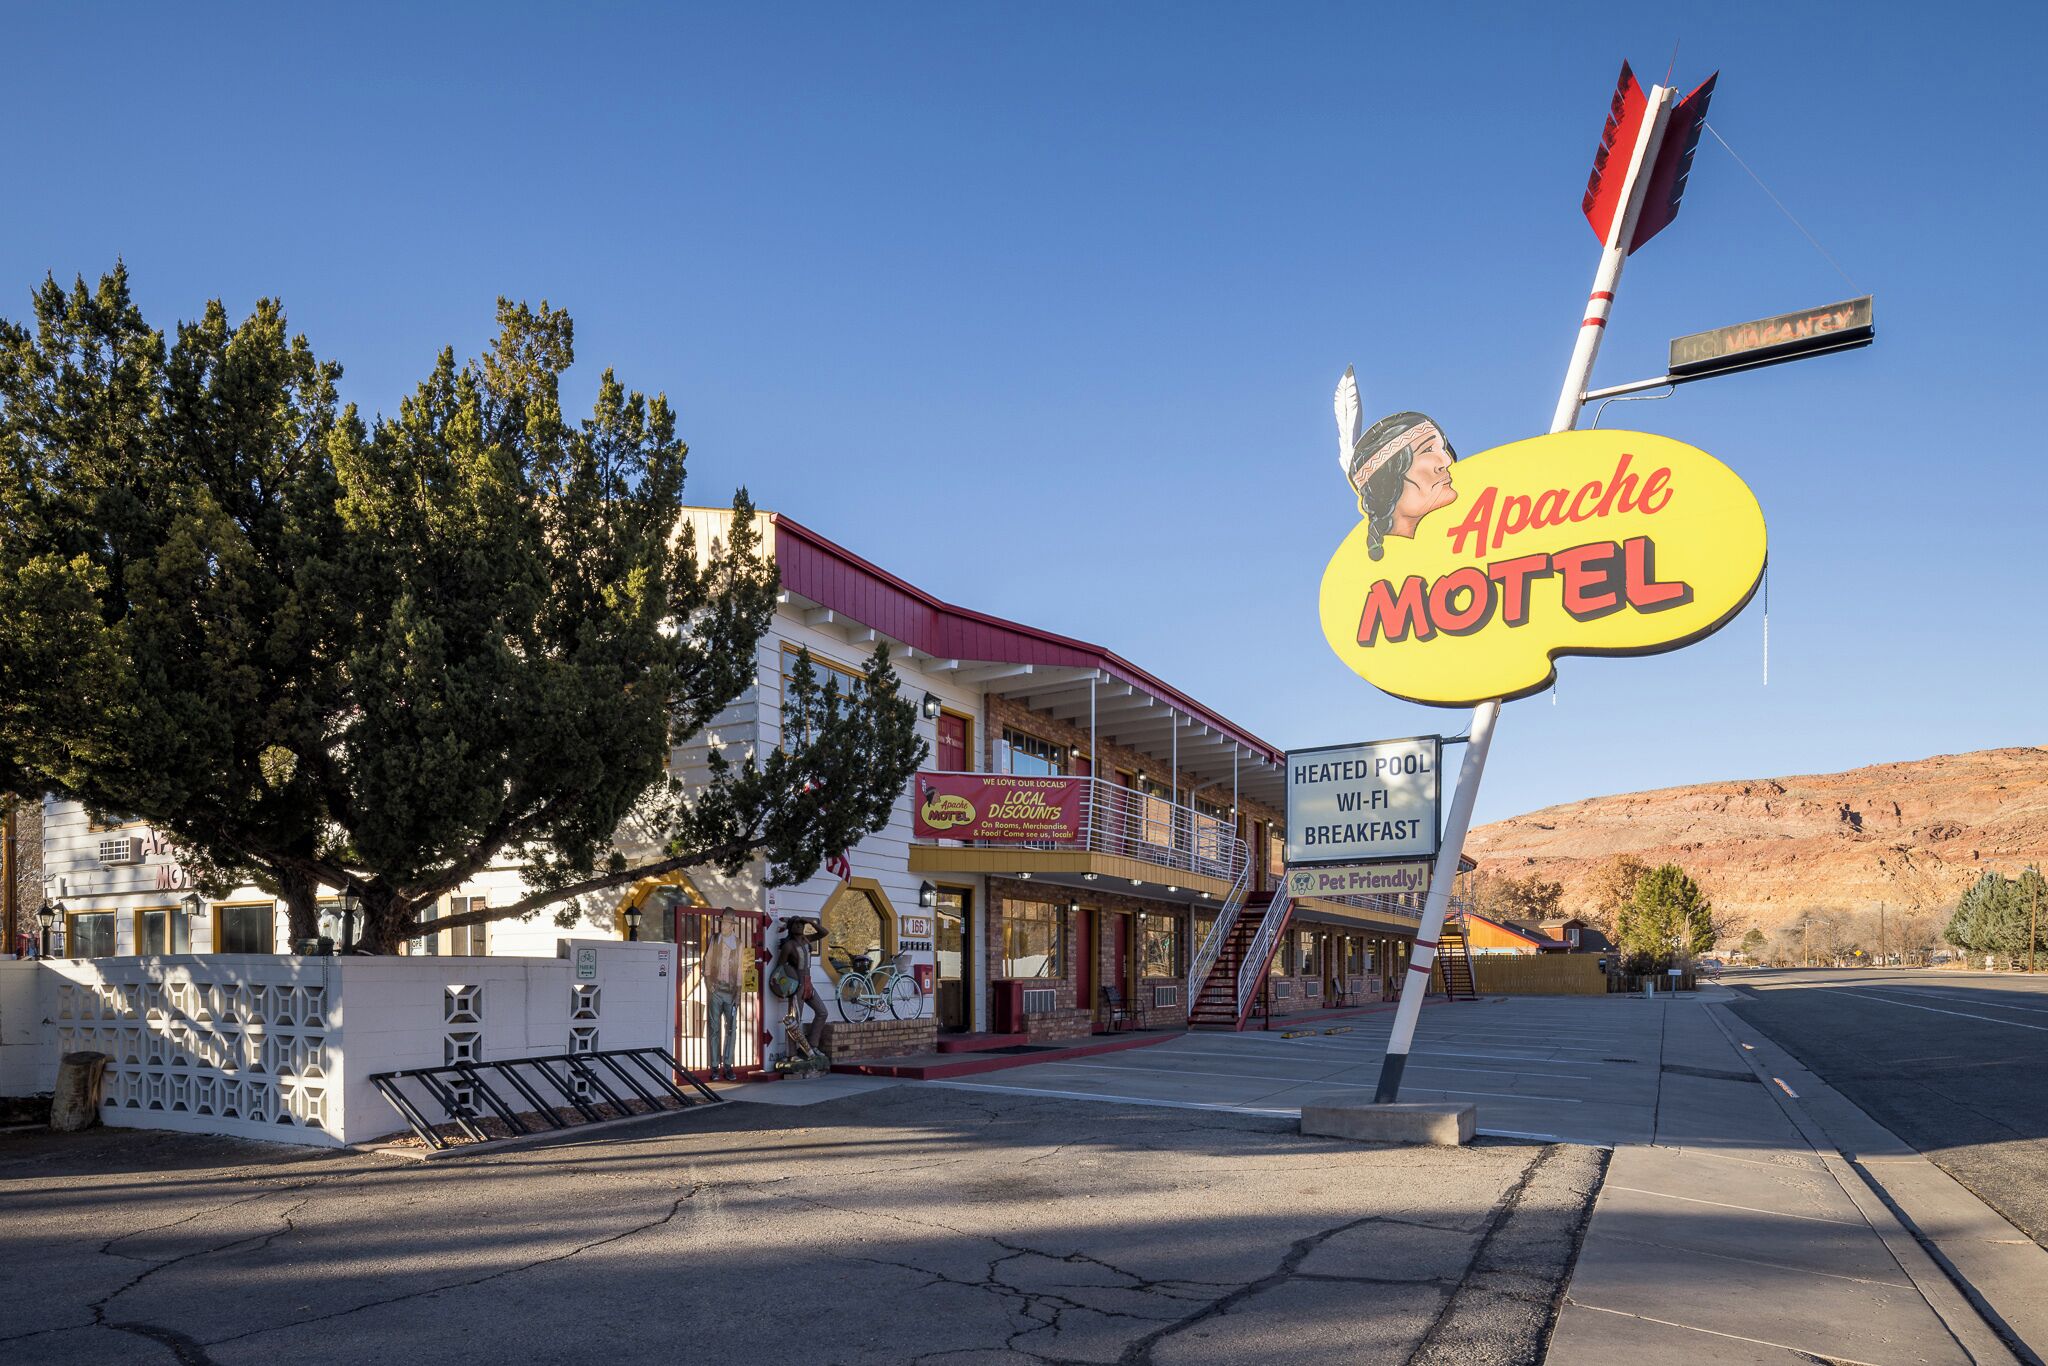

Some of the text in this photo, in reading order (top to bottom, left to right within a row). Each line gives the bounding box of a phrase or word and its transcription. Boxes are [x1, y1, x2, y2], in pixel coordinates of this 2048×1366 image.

[1727, 306, 1854, 352] VACANCY
[1446, 453, 1675, 558] Apache
[1356, 535, 1694, 648] MOTEL
[1294, 753, 1431, 785] HEATED POOL
[983, 778, 1067, 789] WE LOVE OUR LOCALS!
[940, 799, 969, 811] Apache
[1004, 790, 1046, 806] LOCAL
[1336, 789, 1388, 812] WI-FI
[928, 810, 971, 822] MOTEL
[988, 804, 1062, 820] DISCOUNTS
[981, 821, 1068, 831] On Rooms, Merchandise
[1305, 818, 1421, 846] BREAKFAST
[981, 829, 1002, 837] Food!
[1003, 830, 1025, 838] Come
[1039, 832, 1051, 840] us,
[1052, 830, 1074, 839] locals!
[1318, 868, 1423, 891] Pet Friendly!
[912, 920, 923, 933] 166
